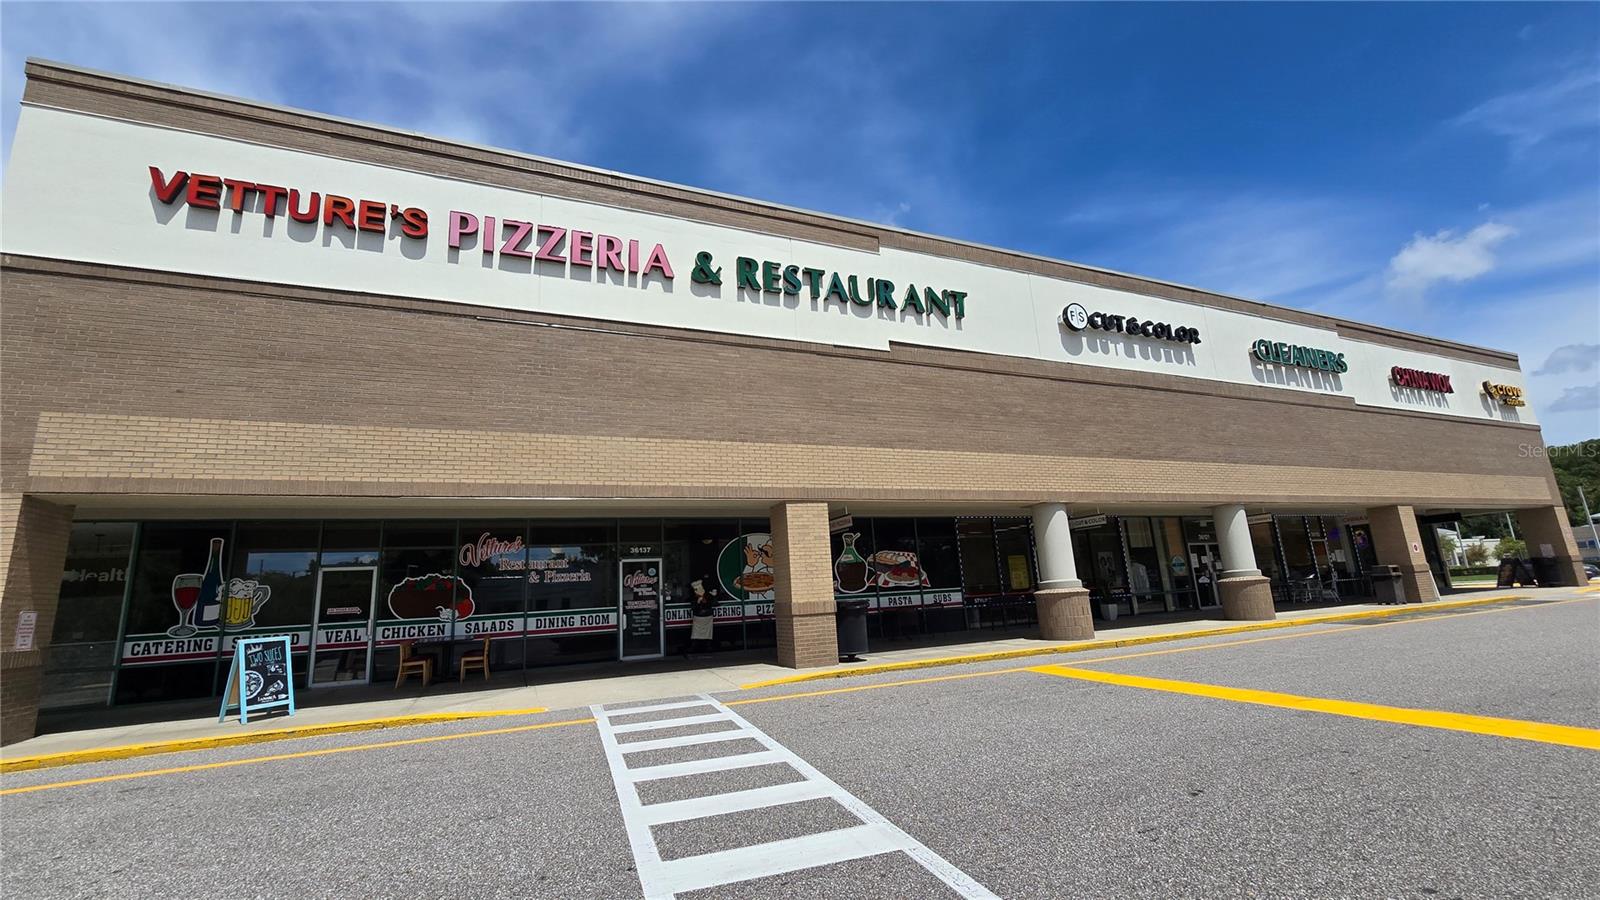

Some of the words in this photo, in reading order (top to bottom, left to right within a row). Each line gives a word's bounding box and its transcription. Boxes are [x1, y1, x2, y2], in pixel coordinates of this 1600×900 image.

[149, 165, 429, 239] VETTURE'S
[448, 210, 675, 279] PIZZERIA
[691, 251, 723, 285] &
[736, 256, 968, 319] RESTAURANT
[1252, 338, 1348, 373] CLEANERS
[1391, 365, 1430, 389] CHINA
[499, 558, 569, 570] Restaurant
[528, 571, 540, 583] &
[544, 569, 592, 583] Pizzeria
[888, 597, 913, 606] PASTA
[933, 594, 952, 603] SUBS
[666, 610, 693, 621] ONLIN
[712, 605, 742, 618] DERING
[464, 620, 514, 634] SALADS
[535, 616, 575, 629] DINING
[580, 614, 610, 627] ROOM
[325, 629, 362, 643] VEAL
[381, 624, 446, 640] CHICKEN
[131, 639, 213, 656] CATERING
